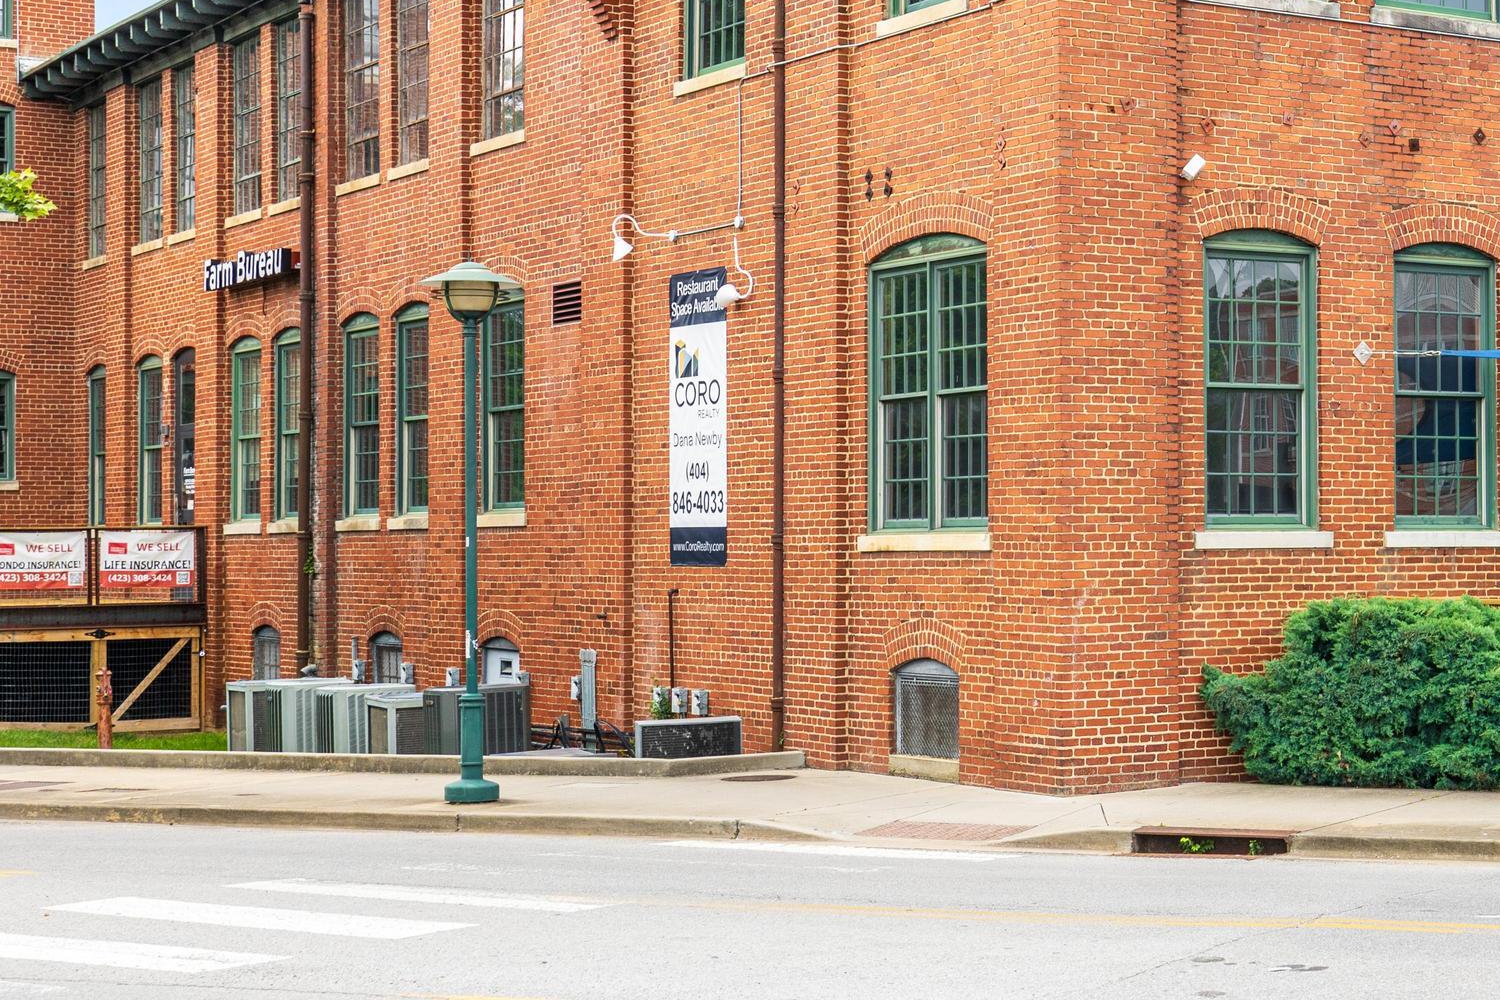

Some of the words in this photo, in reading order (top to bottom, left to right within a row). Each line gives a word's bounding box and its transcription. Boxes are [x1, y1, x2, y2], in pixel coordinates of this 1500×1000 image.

[204, 259, 233, 291] Farm
[236, 248, 282, 283] Bureau
[677, 276, 719, 297] Restaurant
[671, 302, 692, 320] Space
[693, 295, 724, 314] Availab
[675, 379, 720, 408] CORO
[697, 409, 720, 419] REALTY
[673, 433, 693, 447] Dana
[695, 431, 722, 449] Newby
[686, 460, 709, 482] (404)
[672, 490, 724, 514] 846-4033
[26, 543, 44, 553] WE
[47, 543, 73, 553] SELL
[136, 543, 154, 552] WE
[156, 542, 182, 552] SELL
[0, 561, 26, 570] ONDO
[28, 560, 81, 569] INSURANCE!
[104, 560, 127, 570] LIFE
[129, 560, 191, 570] INSURANCE!
[0, 573, 20, 582] 423)
[22, 573, 67, 582] 308-3424
[108, 574, 131, 583] (423)
[132, 574, 172, 583] 308-3424
